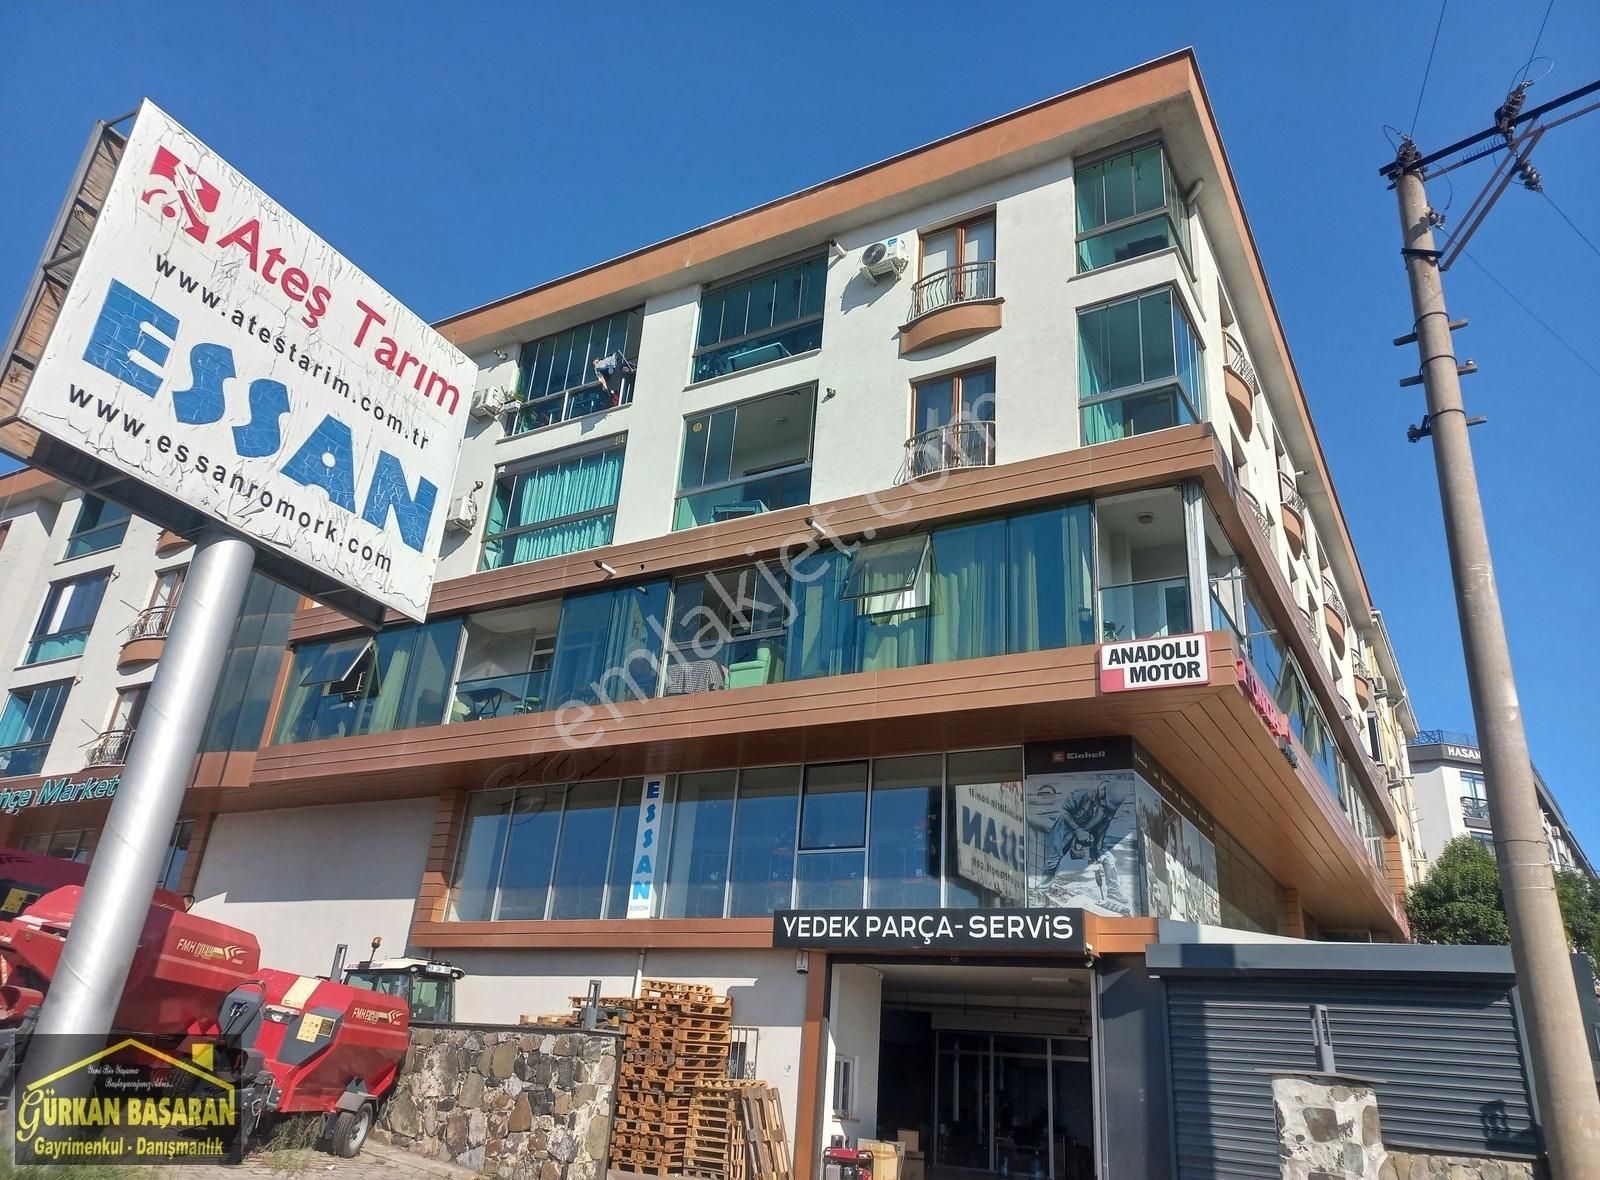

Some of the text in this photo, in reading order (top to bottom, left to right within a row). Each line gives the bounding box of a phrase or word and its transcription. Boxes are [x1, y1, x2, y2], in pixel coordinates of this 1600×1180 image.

[219, 219, 460, 415] Ateş Tarım
[156, 253, 429, 449] www.atestarim.com.tr
[83, 278, 438, 553] ESSAN
[70, 384, 391, 572] www.essanromork.com
[1108, 640, 1199, 665] ANADOLU
[1130, 661, 1200, 683] MOTOR
[1066, 751, 1106, 760] Einhell
[36, 775, 121, 805] Market
[632, 780, 661, 900] ESSAN
[783, 915, 859, 938] YEDEK
[176, 938, 197, 953] FMH
